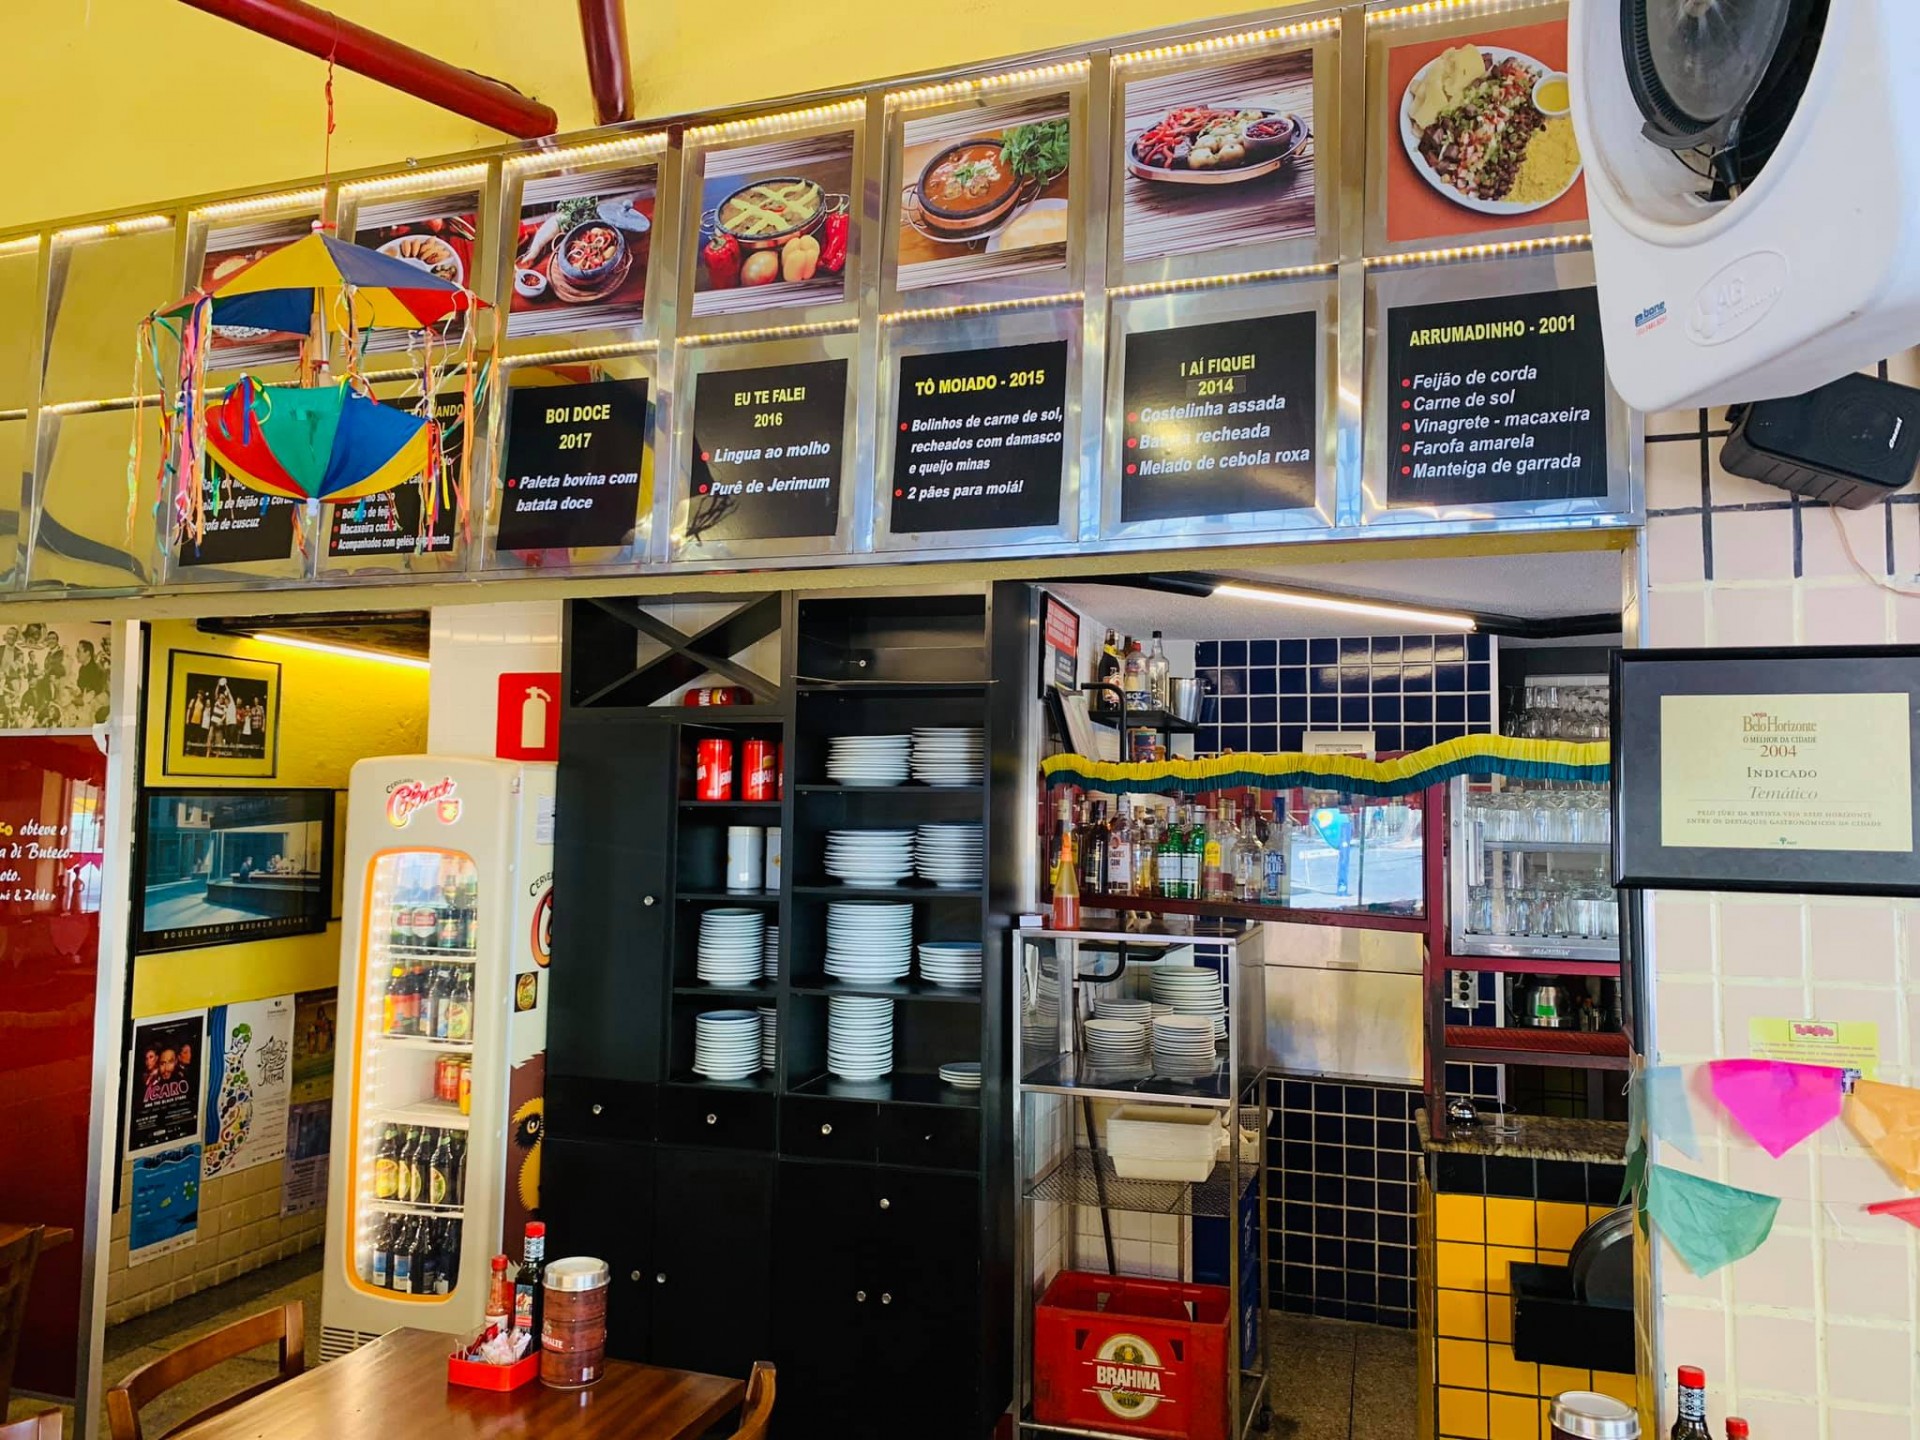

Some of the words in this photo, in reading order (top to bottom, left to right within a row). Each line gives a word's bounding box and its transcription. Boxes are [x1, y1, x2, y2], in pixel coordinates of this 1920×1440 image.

[1410, 320, 1525, 346] ARRUMADINHO
[1539, 315, 1576, 334] 2001
[1181, 362, 1186, 377] I
[1189, 357, 1204, 375] AÍ
[1208, 354, 1256, 374] FIQUEI
[915, 377, 935, 396] TÔ
[939, 374, 997, 394] MOIADO
[1009, 369, 1045, 388] 2015
[1198, 377, 1235, 396] 2014
[1413, 371, 1461, 390] Feijão
[1466, 369, 1486, 384] de
[1490, 365, 1537, 383] corda
[734, 392, 750, 406] EU
[754, 390, 769, 404] TE
[772, 386, 806, 403] FALEI
[1413, 396, 1461, 411] Carne
[1465, 392, 1486, 406] de
[1489, 389, 1515, 404] sol
[546, 407, 569, 424] BOI
[573, 404, 611, 422] DOCE
[1140, 401, 1224, 423] Costelinha
[1227, 394, 1286, 414] assada
[754, 412, 783, 427] 2016
[911, 416, 963, 432] Bolinhos
[966, 414, 980, 428] de
[983, 411, 1019, 426] carne
[1022, 409, 1037, 424] de
[1040, 406, 1063, 422] sol,
[1413, 415, 1490, 434] Vinagrete
[1504, 406, 1591, 427] macaxeira
[559, 432, 592, 449] 2017
[911, 437, 973, 453] recheados
[976, 437, 1002, 448] com
[1005, 431, 1062, 447] damasco
[1195, 422, 1271, 443] recheada
[765, 447, 782, 459] ao
[786, 441, 830, 457] molho
[1413, 438, 1464, 456] Farofa
[1469, 433, 1535, 451] amarela
[909, 464, 916, 474] e
[919, 459, 953, 476] queijo
[955, 457, 991, 472] minas
[1139, 458, 1192, 476] Melado
[1196, 454, 1216, 470] de
[1219, 449, 1271, 468] cebola
[1274, 447, 1310, 463] roxa
[1413, 460, 1486, 479] Manteiga
[1491, 457, 1512, 473] de
[1516, 453, 1582, 475] garrada
[519, 475, 560, 490] Paleta
[563, 472, 605, 487] bovina
[609, 472, 638, 484] com
[710, 480, 743, 496] Purê
[746, 479, 763, 493] de
[767, 476, 830, 492] Jerimum
[907, 486, 916, 500] 2
[919, 484, 950, 501] pães
[952, 484, 983, 500] para
[986, 480, 1025, 496] moiá!
[235, 495, 258, 510] feijão
[367, 506, 376, 518] de
[516, 498, 557, 512] batata
[560, 496, 593, 510] doce
[220, 518, 231, 530] de
[231, 517, 260, 528] cuscuz
[338, 536, 381, 552] Acompanhados
[382, 538, 395, 547] com
[1768, 715, 1816, 732] Horizonte
[1760, 744, 1797, 758] 2004
[1750, 786, 1817, 801] Temático
[60, 825, 68, 836] o
[10, 842, 22, 859] di
[14, 889, 21, 902] &
[1097, 1365, 1161, 1391] BRAHMA
